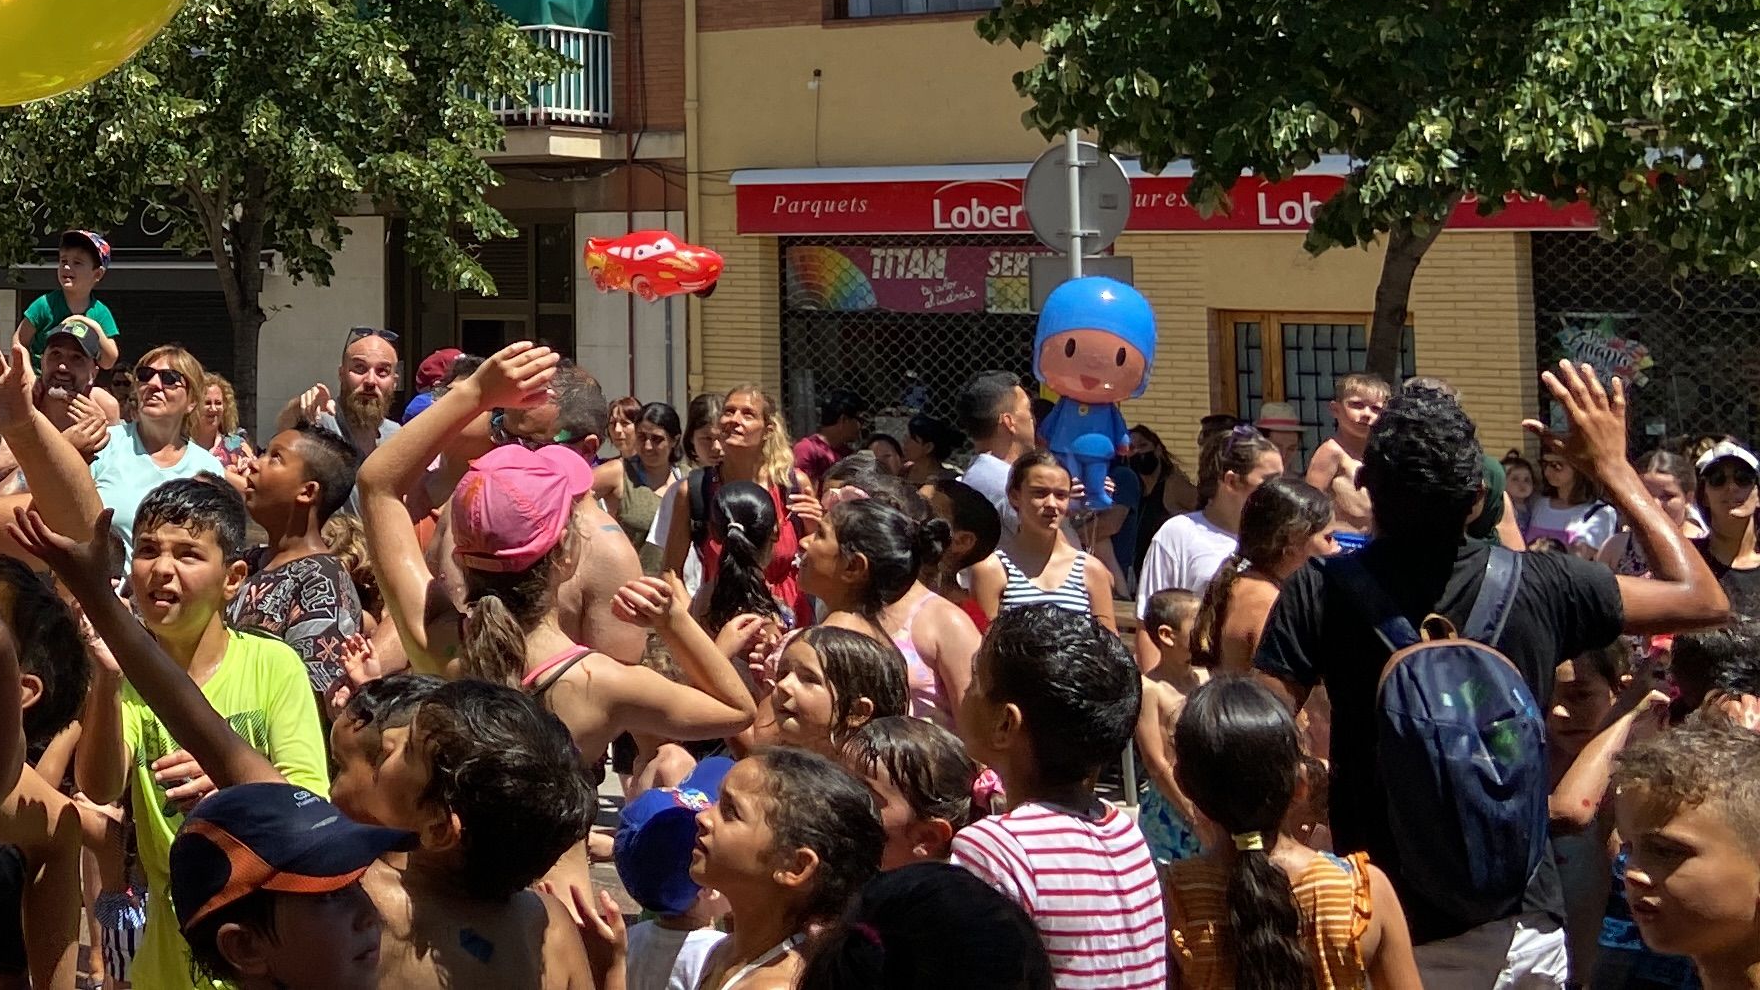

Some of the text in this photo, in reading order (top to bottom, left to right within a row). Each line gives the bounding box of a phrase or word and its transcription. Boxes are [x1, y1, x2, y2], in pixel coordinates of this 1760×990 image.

[772, 190, 1324, 229] Parquets Lober ures Lob
[869, 247, 948, 280] TITAN
